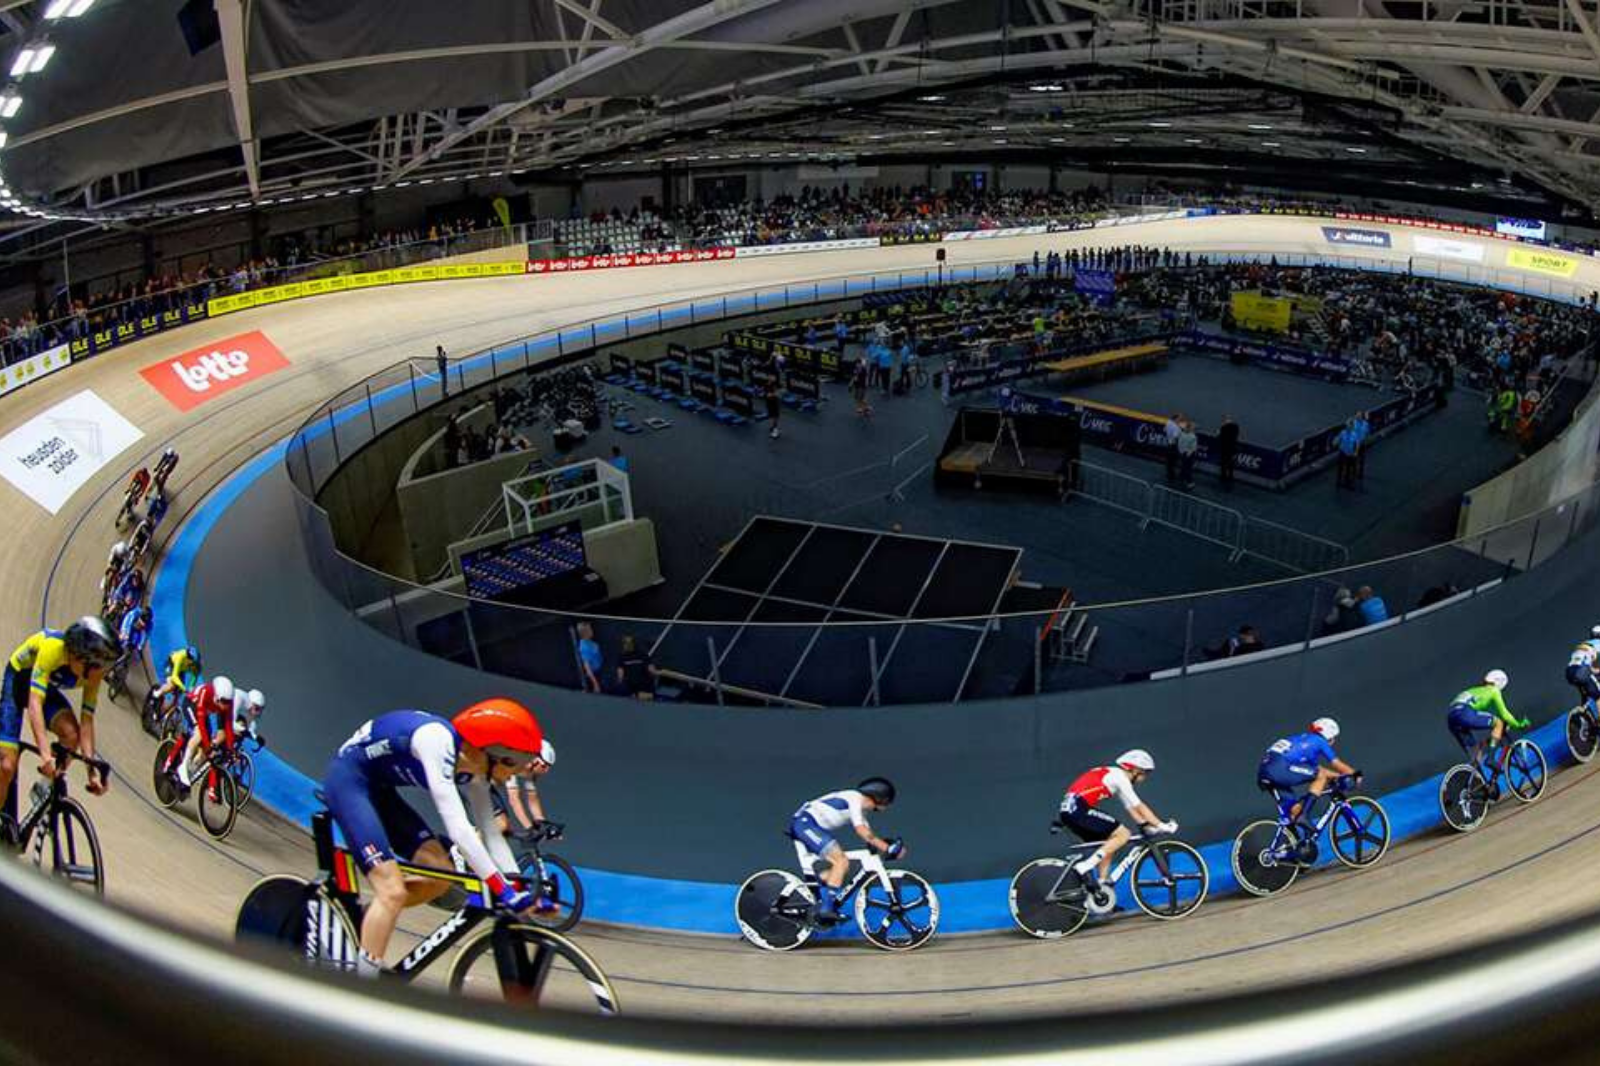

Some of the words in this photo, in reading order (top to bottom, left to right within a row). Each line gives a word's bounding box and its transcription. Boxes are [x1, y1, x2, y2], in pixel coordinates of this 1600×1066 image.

[172, 350, 249, 392] lotto
[17, 436, 66, 469] heusden
[48, 448, 79, 474] zolder
[403, 909, 467, 970] LOOK
